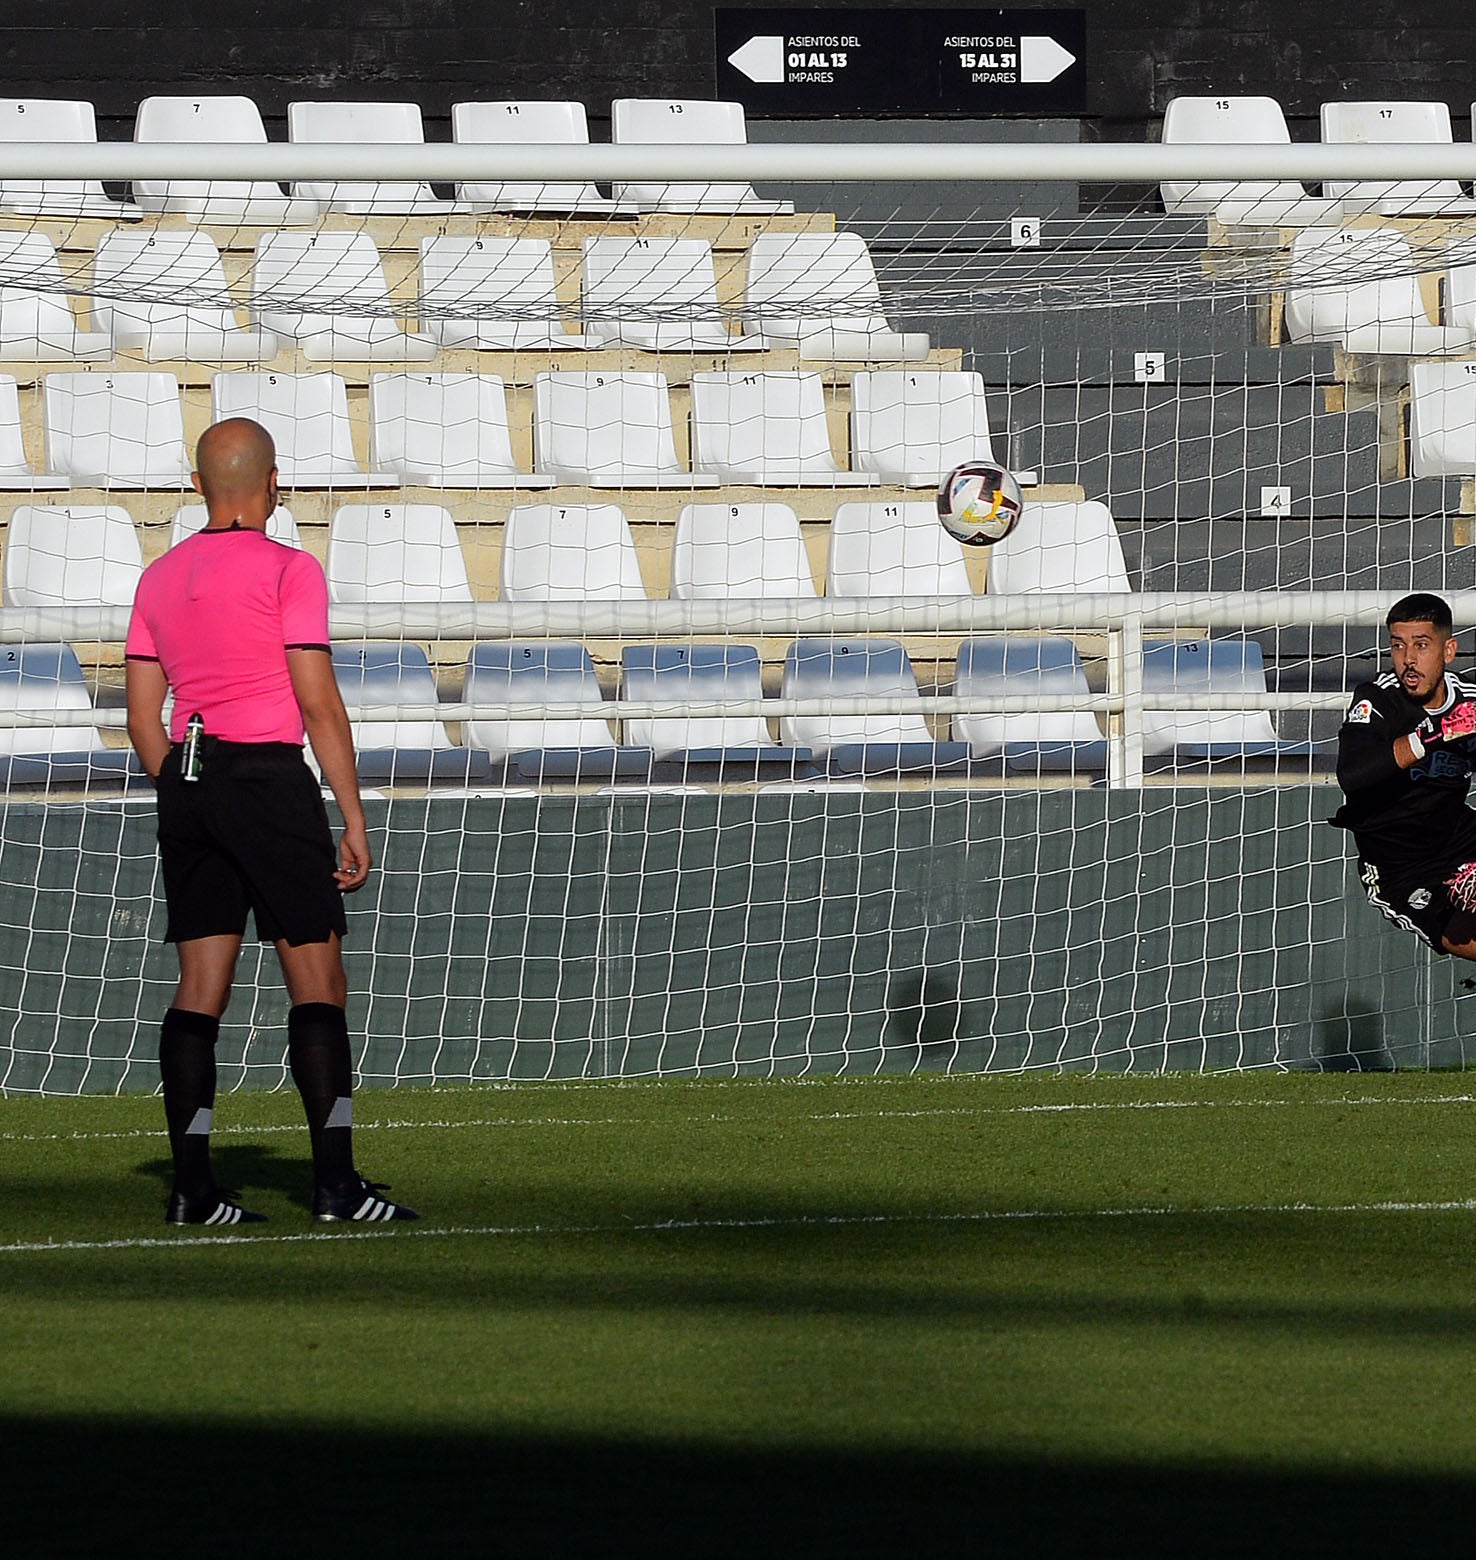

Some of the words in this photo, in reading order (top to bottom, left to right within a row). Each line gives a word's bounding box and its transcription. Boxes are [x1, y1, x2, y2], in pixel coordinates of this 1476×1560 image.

[787, 36, 839, 48] ASIENTOS
[841, 37, 861, 48] DEL
[944, 37, 994, 48] ASIENTOS
[996, 37, 1016, 48] DEL
[788, 53, 805, 68] 01
[807, 53, 829, 68] AL
[832, 53, 848, 68] 13
[959, 53, 976, 68] 15
[977, 53, 1000, 68] AL
[1001, 53, 1017, 68] 31
[788, 72, 834, 83] IMPARES
[971, 72, 1017, 84] IMPARES
[17, 104, 25, 114] 5
[193, 103, 200, 113] 7
[506, 105, 520, 115] 11
[668, 104, 683, 114] 13
[1216, 100, 1230, 110] 15
[1379, 110, 1393, 119] 17
[1020, 224, 1032, 239] 6
[148, 237, 156, 247] 5
[474, 241, 484, 250] 9
[1144, 360, 1155, 376] 5
[1464, 365, 1476, 375] 15
[105, 380, 114, 389] 3
[269, 375, 277, 385] 5
[425, 376, 432, 386] 7
[596, 377, 604, 387] 9
[910, 377, 916, 386] 1
[384, 508, 391, 519] 5
[559, 510, 567, 520] 7
[731, 507, 739, 517] 9
[884, 507, 897, 517] 11
[7, 651, 16, 662] 2
[523, 648, 532, 659] 5
[676, 650, 685, 660] 7
